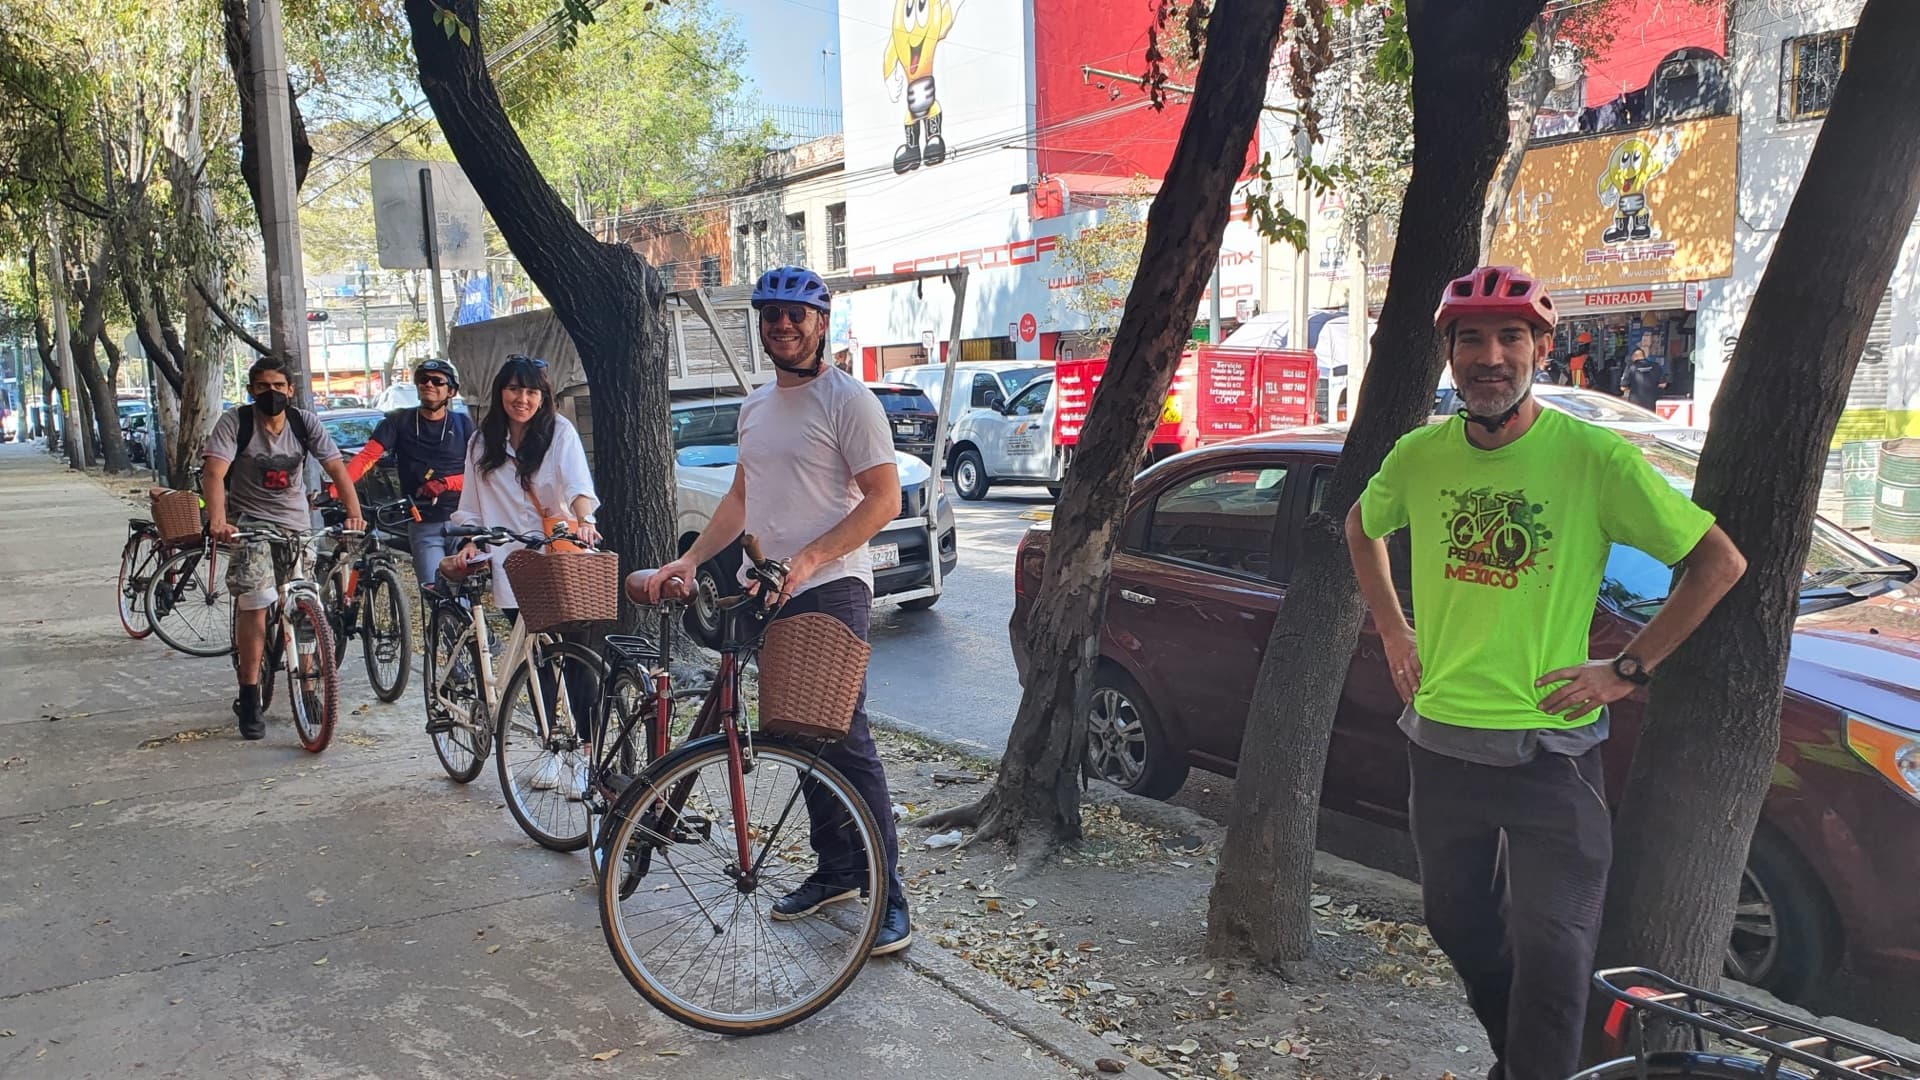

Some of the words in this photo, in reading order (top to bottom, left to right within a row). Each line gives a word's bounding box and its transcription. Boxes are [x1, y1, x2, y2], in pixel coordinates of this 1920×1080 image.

[1588, 292, 1647, 305] ENTRADA
[1215, 396, 1239, 404] CDMX
[1444, 563, 1518, 590] MEXICO
